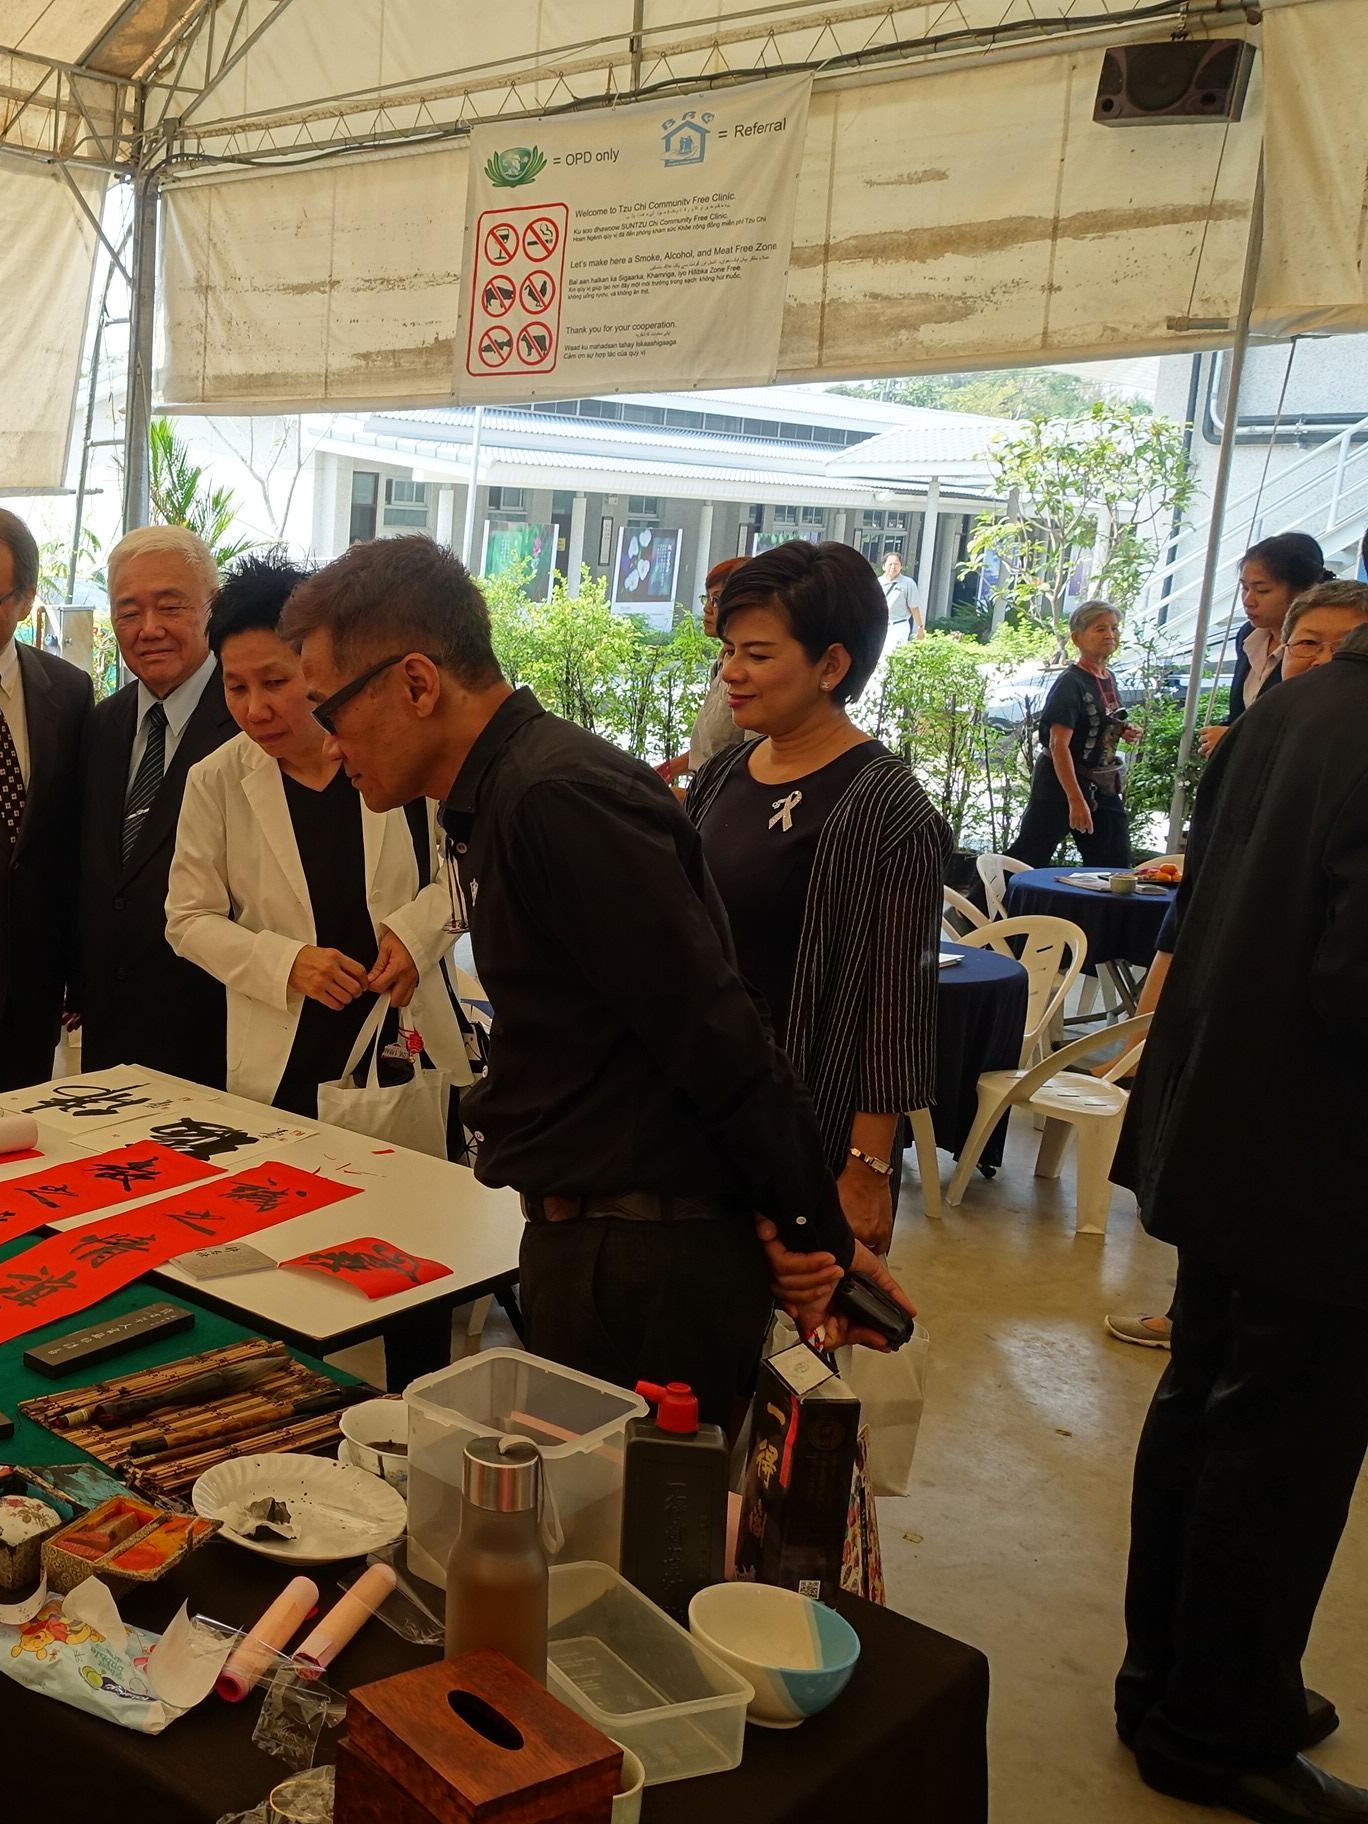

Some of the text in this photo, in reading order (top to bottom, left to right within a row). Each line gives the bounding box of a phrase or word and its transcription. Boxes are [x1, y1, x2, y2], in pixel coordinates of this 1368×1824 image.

[734, 118, 786, 138] Referral
[565, 152, 592, 167] OPD
[595, 147, 620, 163] only
[575, 209, 608, 218] Welcome
[610, 206, 617, 214] to
[618, 204, 632, 213] Tzu
[633, 202, 646, 211] Chi
[648, 198, 691, 210] Community
[692, 195, 710, 204] Free
[570, 260, 587, 269] Let's
[588, 259, 608, 267] make
[609, 257, 626, 265] here
[634, 253, 662, 263] Smoke,
[664, 250, 695, 260] Alcohol,
[697, 248, 712, 257] and
[713, 246, 733, 255] Meat
[735, 244, 754, 253] Free
[755, 242, 777, 252] Zone
[565, 320, 677, 335] Thank you for your cooperation.
